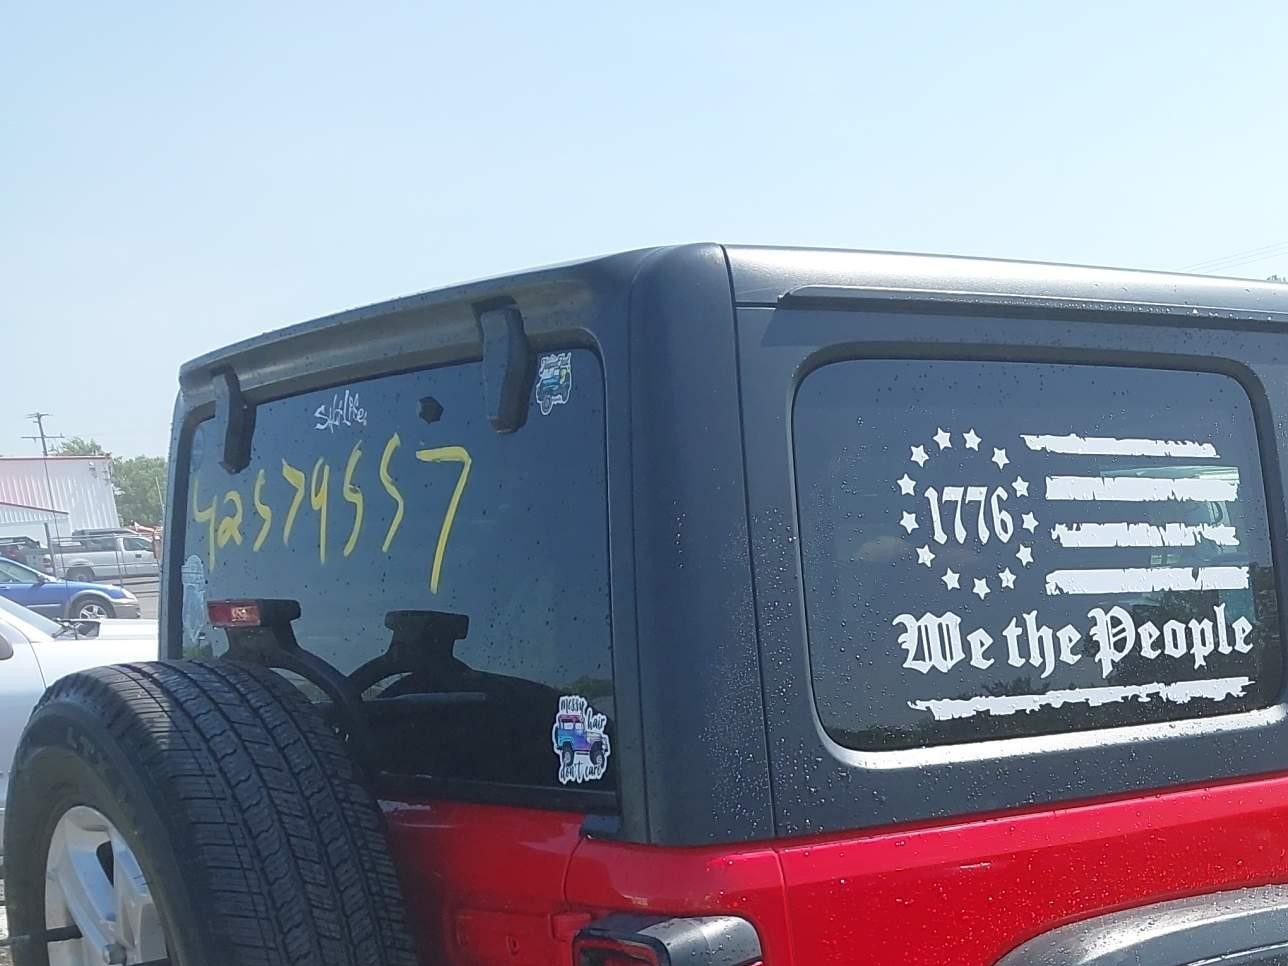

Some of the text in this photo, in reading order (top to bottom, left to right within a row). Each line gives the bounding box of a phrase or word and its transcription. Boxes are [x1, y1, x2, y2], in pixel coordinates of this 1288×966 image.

[193, 432, 472, 594] 42579557
[923, 485, 1014, 545] 1776
[891, 602, 1256, 678] We the People
[588, 709, 606, 730] hair
